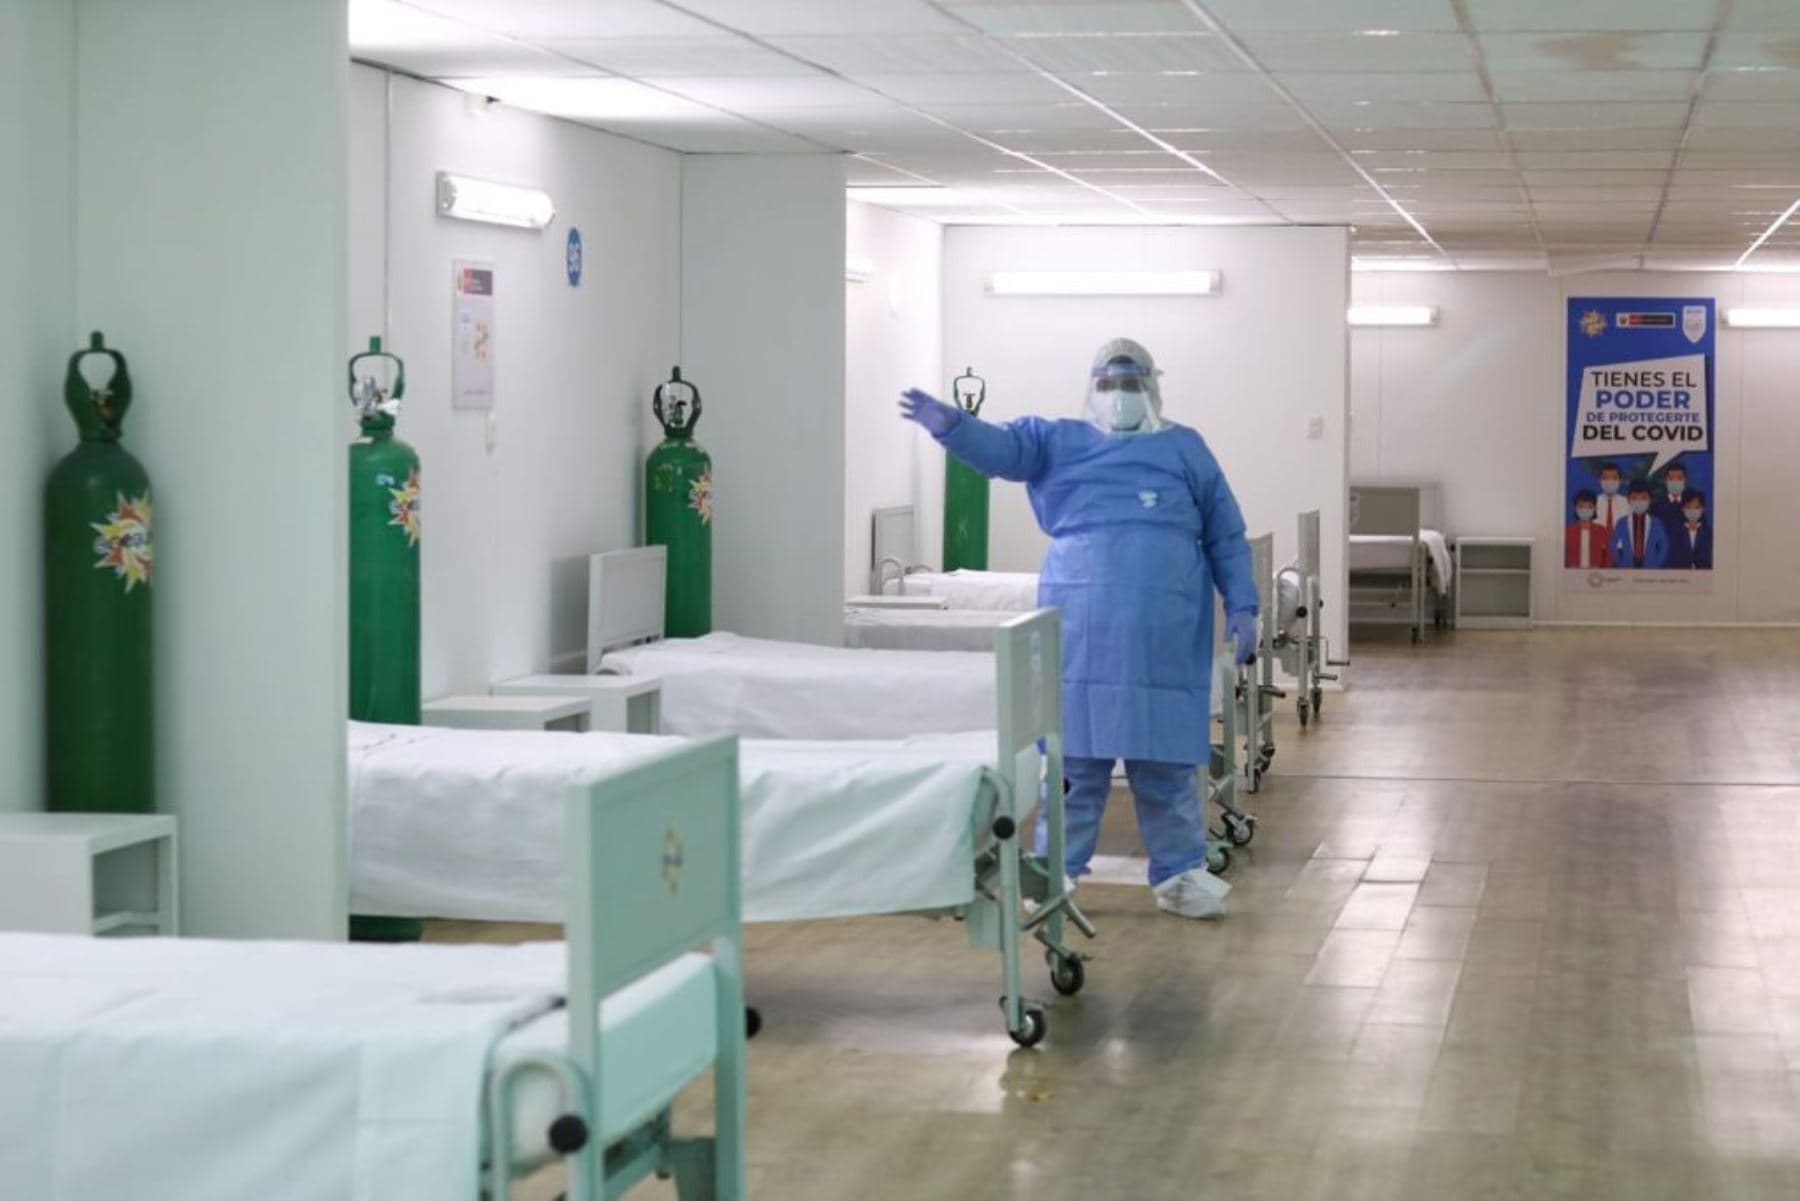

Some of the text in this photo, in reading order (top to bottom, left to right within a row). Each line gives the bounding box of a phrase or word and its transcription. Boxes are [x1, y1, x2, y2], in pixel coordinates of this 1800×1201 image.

[1591, 371, 1697, 387] TIENES EL
[1596, 390, 1691, 409] PODER
[1586, 412, 1700, 422] DE PROTEGERTE
[1583, 425, 1703, 441] DEL COVID
